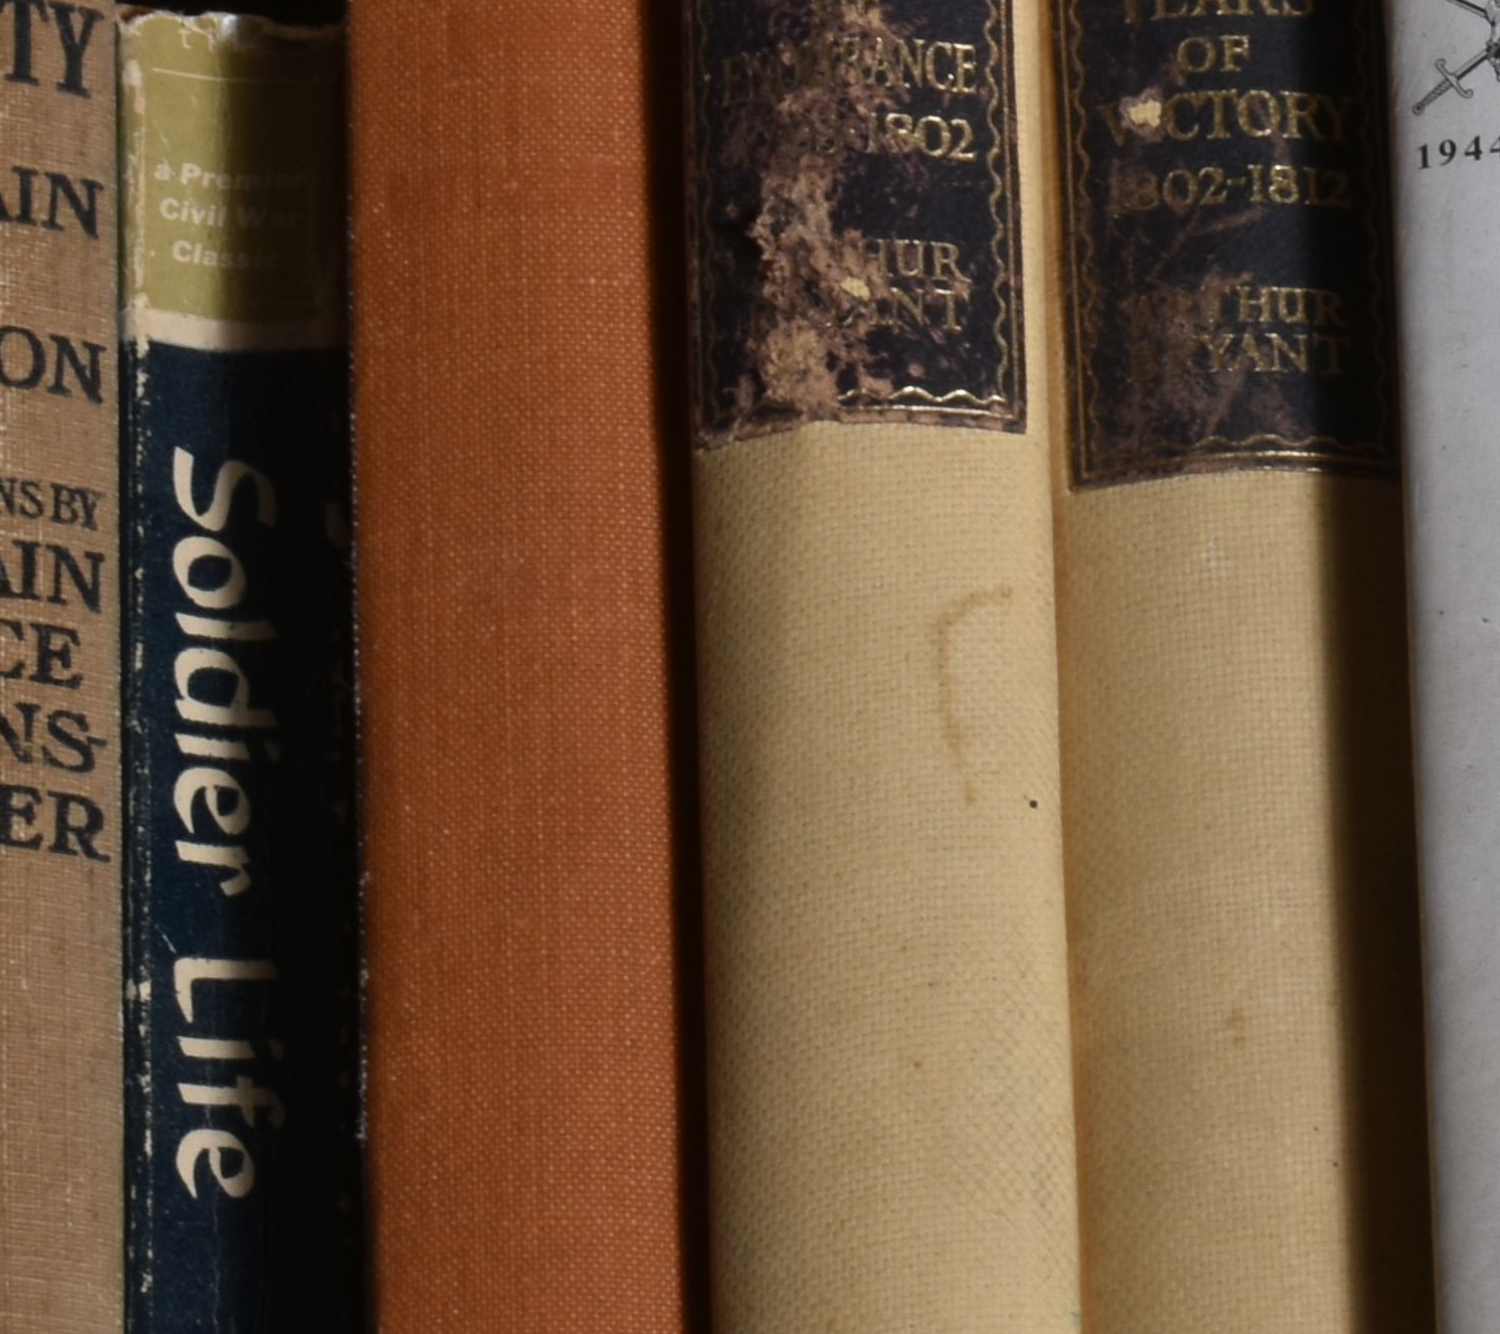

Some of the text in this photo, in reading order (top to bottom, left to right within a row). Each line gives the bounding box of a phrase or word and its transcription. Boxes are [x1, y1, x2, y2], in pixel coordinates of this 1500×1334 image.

[1175, 33, 1251, 75] OF
[1097, 88, 1354, 148] VCTORY
[158, 197, 226, 228] Civil
[1108, 163, 1353, 218] 1802-1812
[49, 483, 105, 533] BY
[171, 446, 285, 1201] Soldier Life
